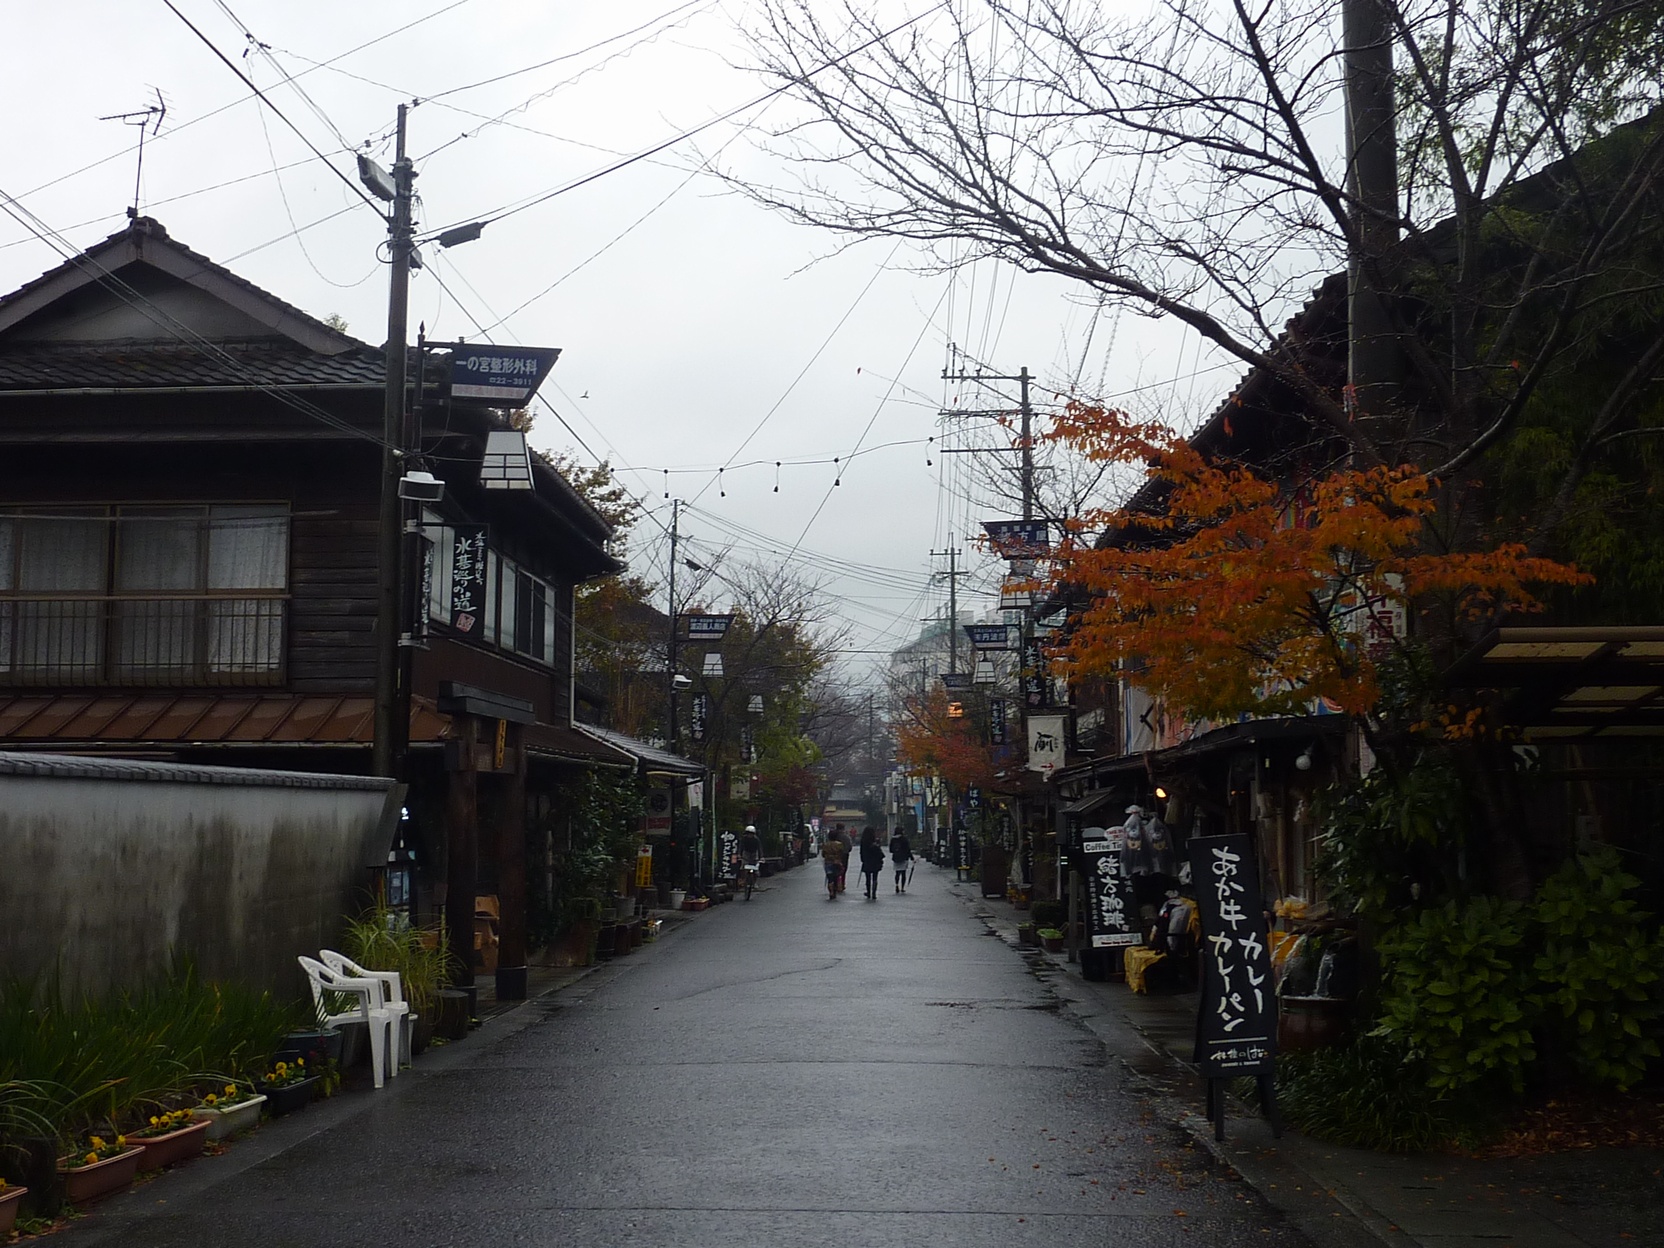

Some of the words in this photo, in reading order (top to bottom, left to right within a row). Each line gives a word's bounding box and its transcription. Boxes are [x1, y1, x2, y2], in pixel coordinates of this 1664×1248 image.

[455, 355, 538, 376] 一の宮整形外科
[1085, 842, 1111, 851] Coffee
[1096, 854, 1126, 930] 緒方珈琲
